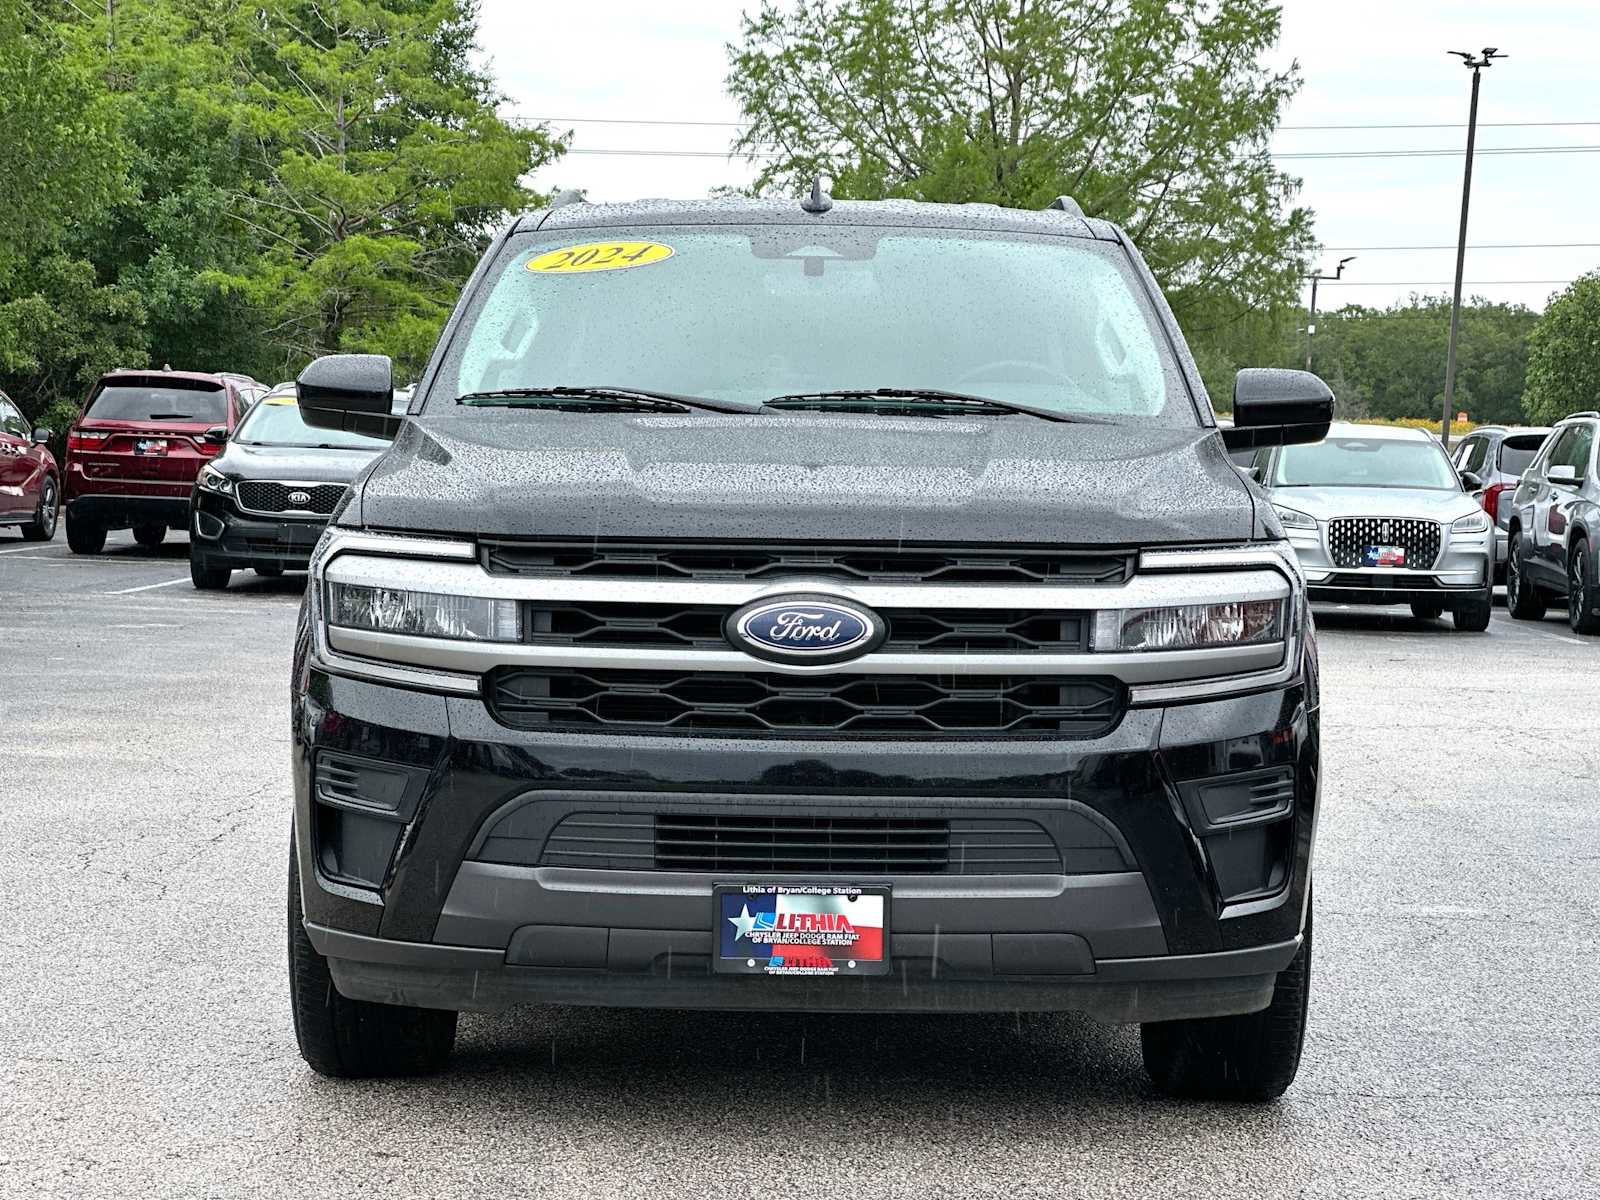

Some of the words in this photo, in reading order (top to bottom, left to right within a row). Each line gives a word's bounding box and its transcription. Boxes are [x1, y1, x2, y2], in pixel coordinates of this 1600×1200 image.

[543, 244, 655, 270] 2024
[291, 494, 307, 502] KIA
[769, 611, 842, 641] Ford
[743, 886, 765, 894] Lithia
[778, 886, 831, 895] Bryan/College
[775, 912, 855, 933] LITHIA
